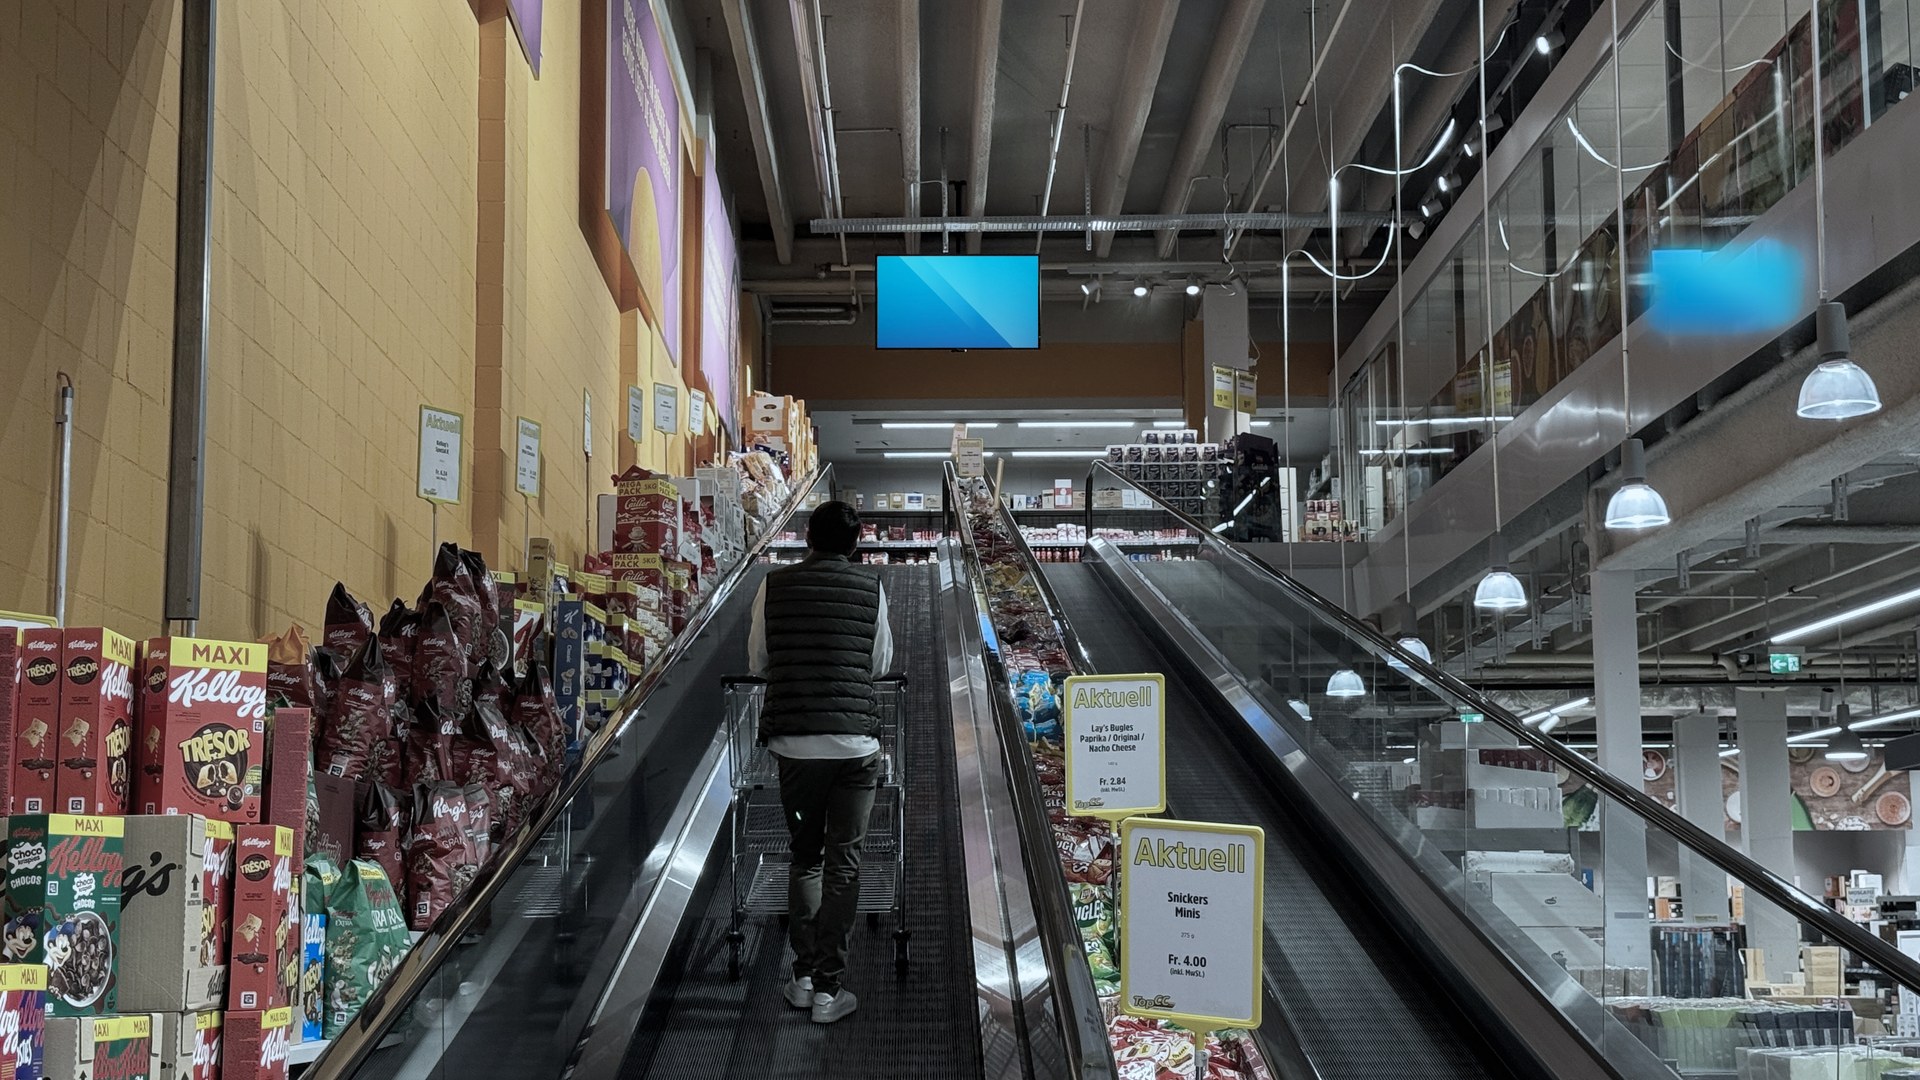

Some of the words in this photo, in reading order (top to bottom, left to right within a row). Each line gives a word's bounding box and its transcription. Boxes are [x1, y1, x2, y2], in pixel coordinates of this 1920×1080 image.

[619, 488, 641, 496] PACK
[614, 560, 639, 568] PACK
[28, 640, 57, 651] Kellogg's
[68, 640, 98, 651] Kellogg's
[111, 635, 131, 660] MAXI
[192, 643, 250, 666] MAXI
[1073, 686, 1152, 709] Aktuell
[1091, 724, 1109, 735] Lay's
[1110, 723, 1134, 733] Bugles
[1080, 734, 1107, 743] Paprika
[1113, 733, 1141, 743] Original
[1089, 744, 1111, 753] Nacho
[1112, 743, 1137, 752] Cheese
[1099, 777, 1109, 786] Fr.
[1110, 776, 1127, 786] 2.84
[75, 818, 104, 832] MAXI
[242, 837, 271, 850] Kellogg's
[1134, 837, 1246, 874] Aktuell
[1167, 891, 1209, 906] Snickers
[1175, 906, 1201, 919] Minis
[1168, 953, 1181, 966] Fr.
[1183, 955, 1207, 968] 4.00
[21, 968, 38, 985] MAXI
[1170, 967, 1185, 976] (inkl.
[1185, 968, 1206, 978] MwSt.)
[1133, 995, 1172, 1010] TopCC
